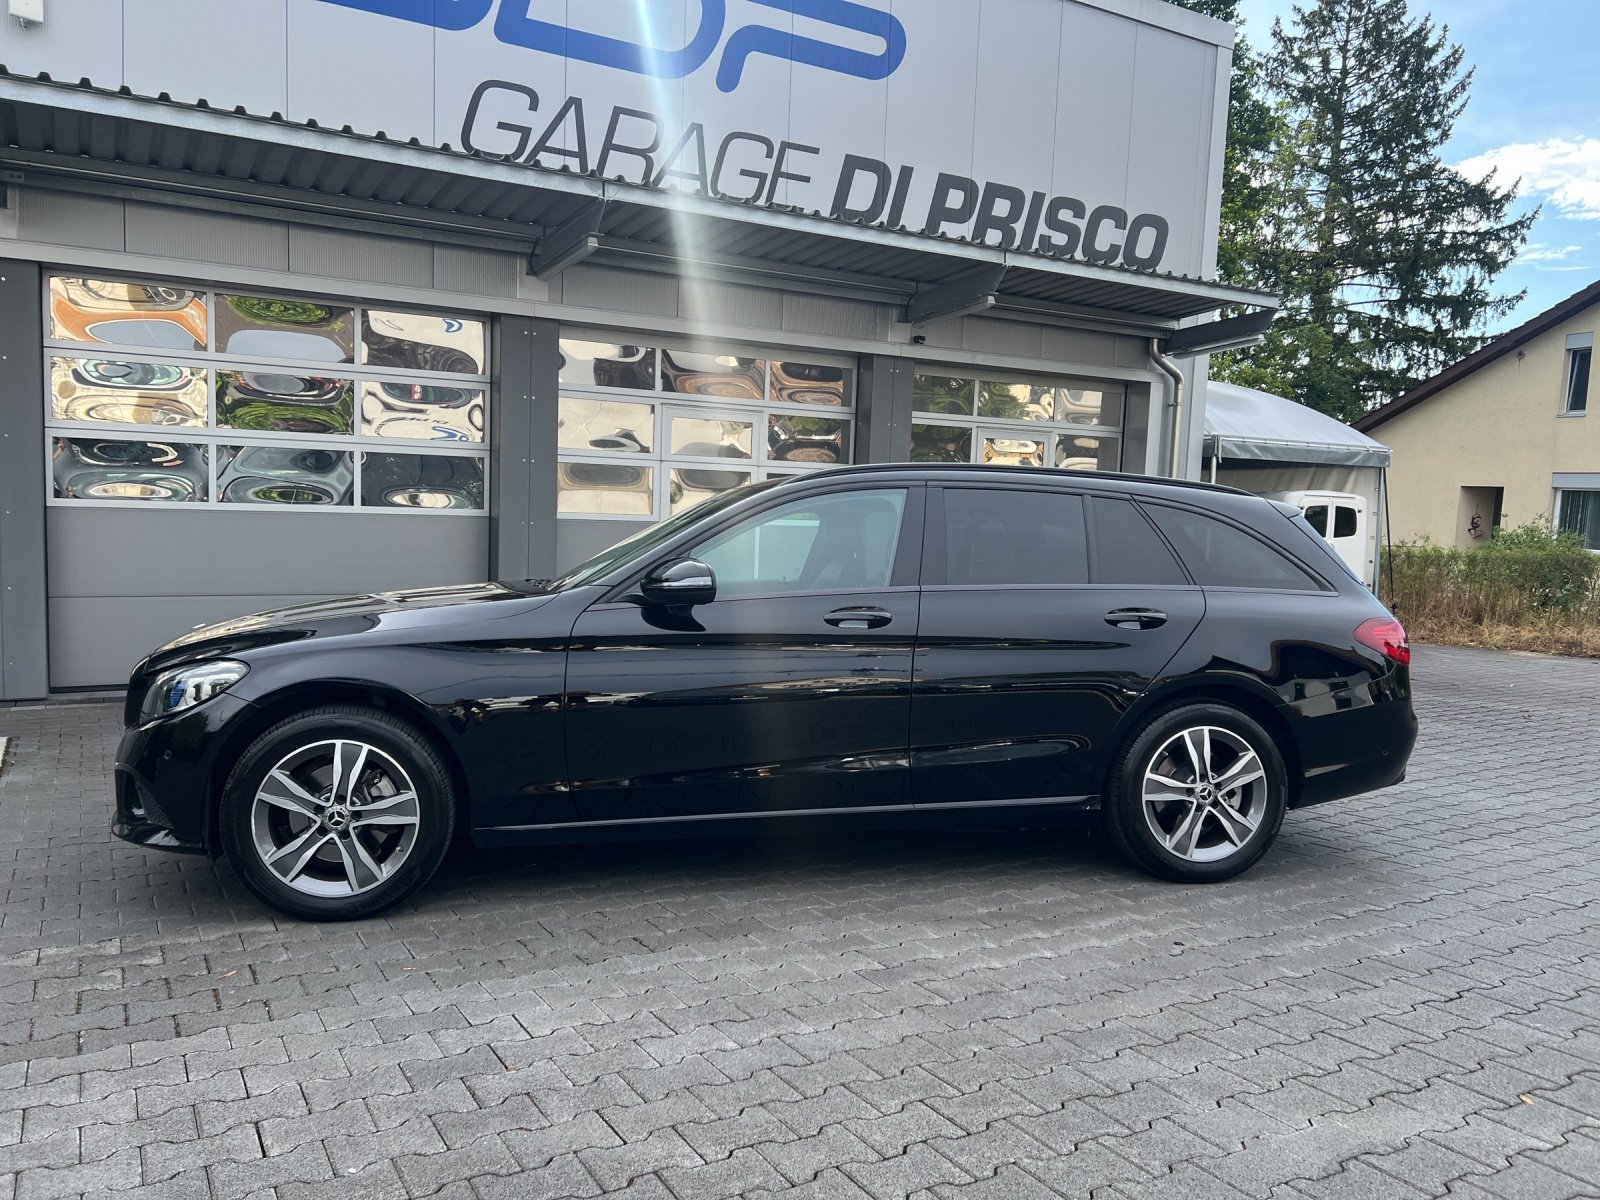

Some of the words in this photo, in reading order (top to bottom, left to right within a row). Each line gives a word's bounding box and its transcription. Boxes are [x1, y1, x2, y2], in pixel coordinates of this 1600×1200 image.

[460, 79, 821, 213] GARAGE
[829, 153, 914, 229] DI
[925, 171, 1169, 271] PRISCO
